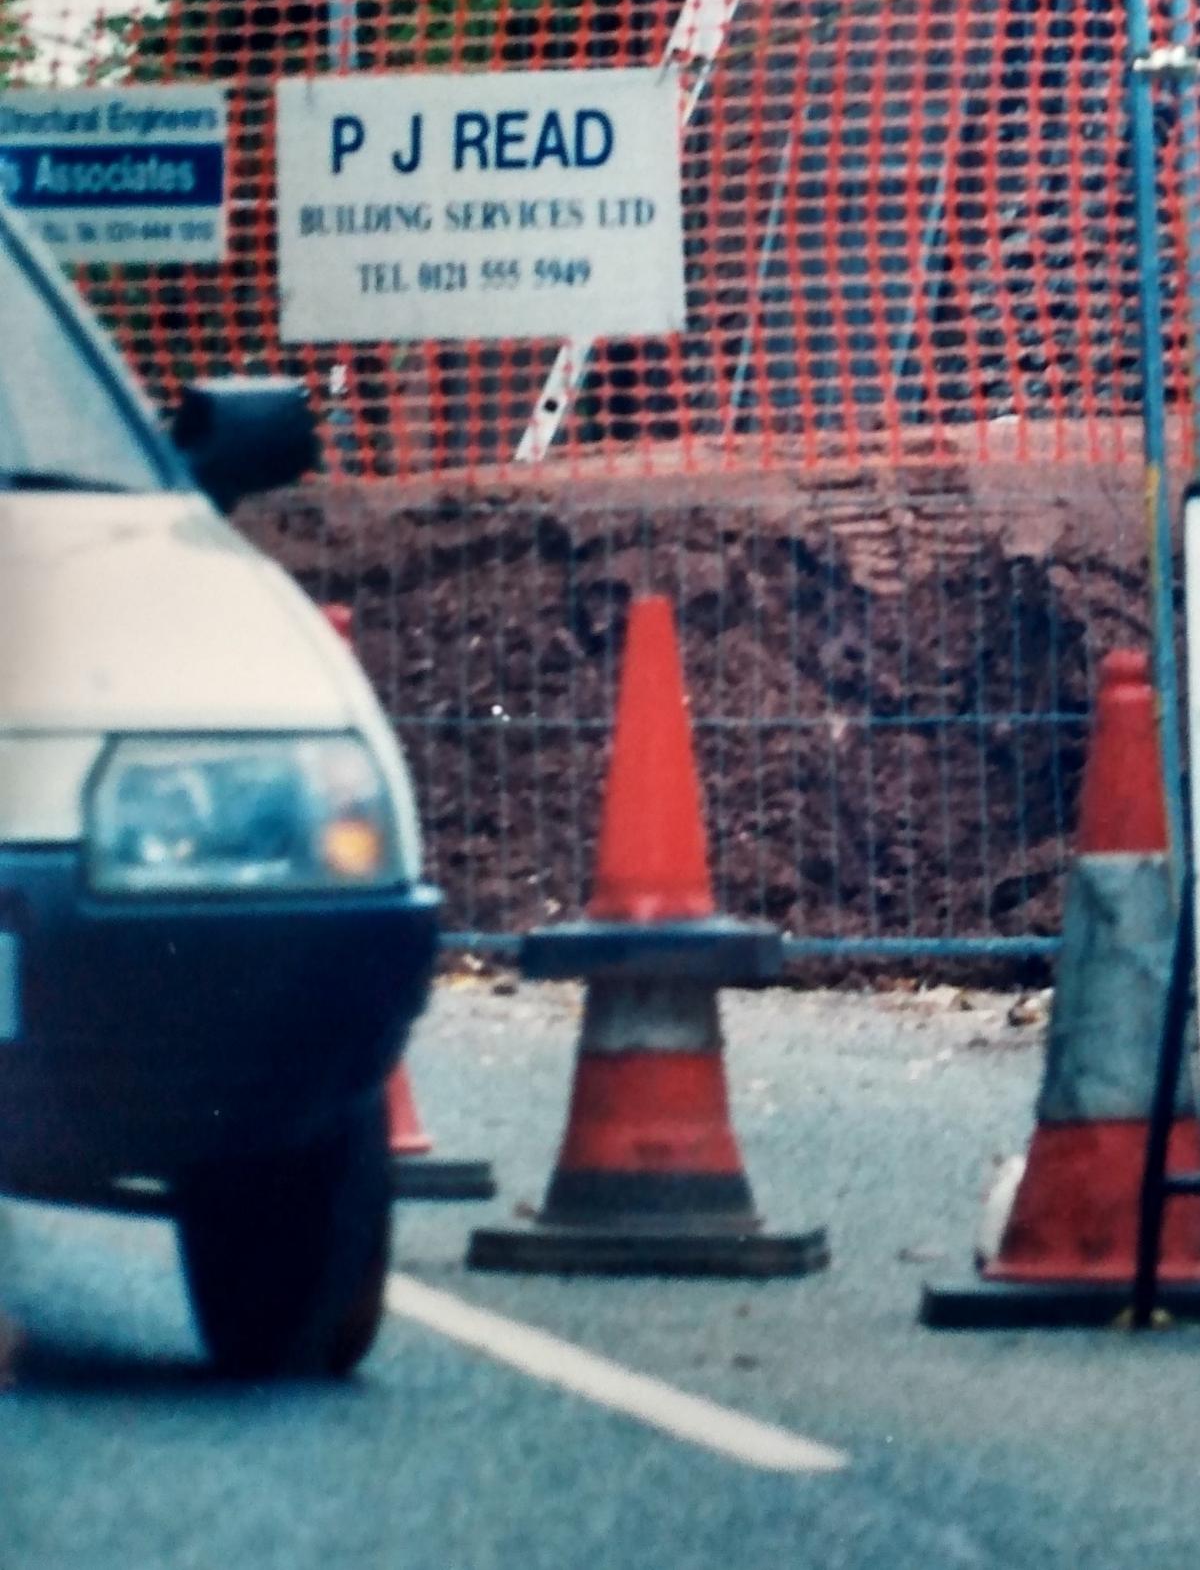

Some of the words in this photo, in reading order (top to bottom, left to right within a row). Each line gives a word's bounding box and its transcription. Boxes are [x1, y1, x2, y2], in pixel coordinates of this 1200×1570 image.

[332, 115, 364, 175] P
[392, 112, 421, 173] J
[454, 109, 613, 170] READ
[35, 154, 195, 194] Associates
[300, 200, 433, 235] BUILDING
[445, 199, 584, 231] SERVICES
[598, 196, 656, 228] LTD
[359, 262, 409, 294] TEL
[417, 260, 467, 292] 0121
[481, 259, 520, 291] 555
